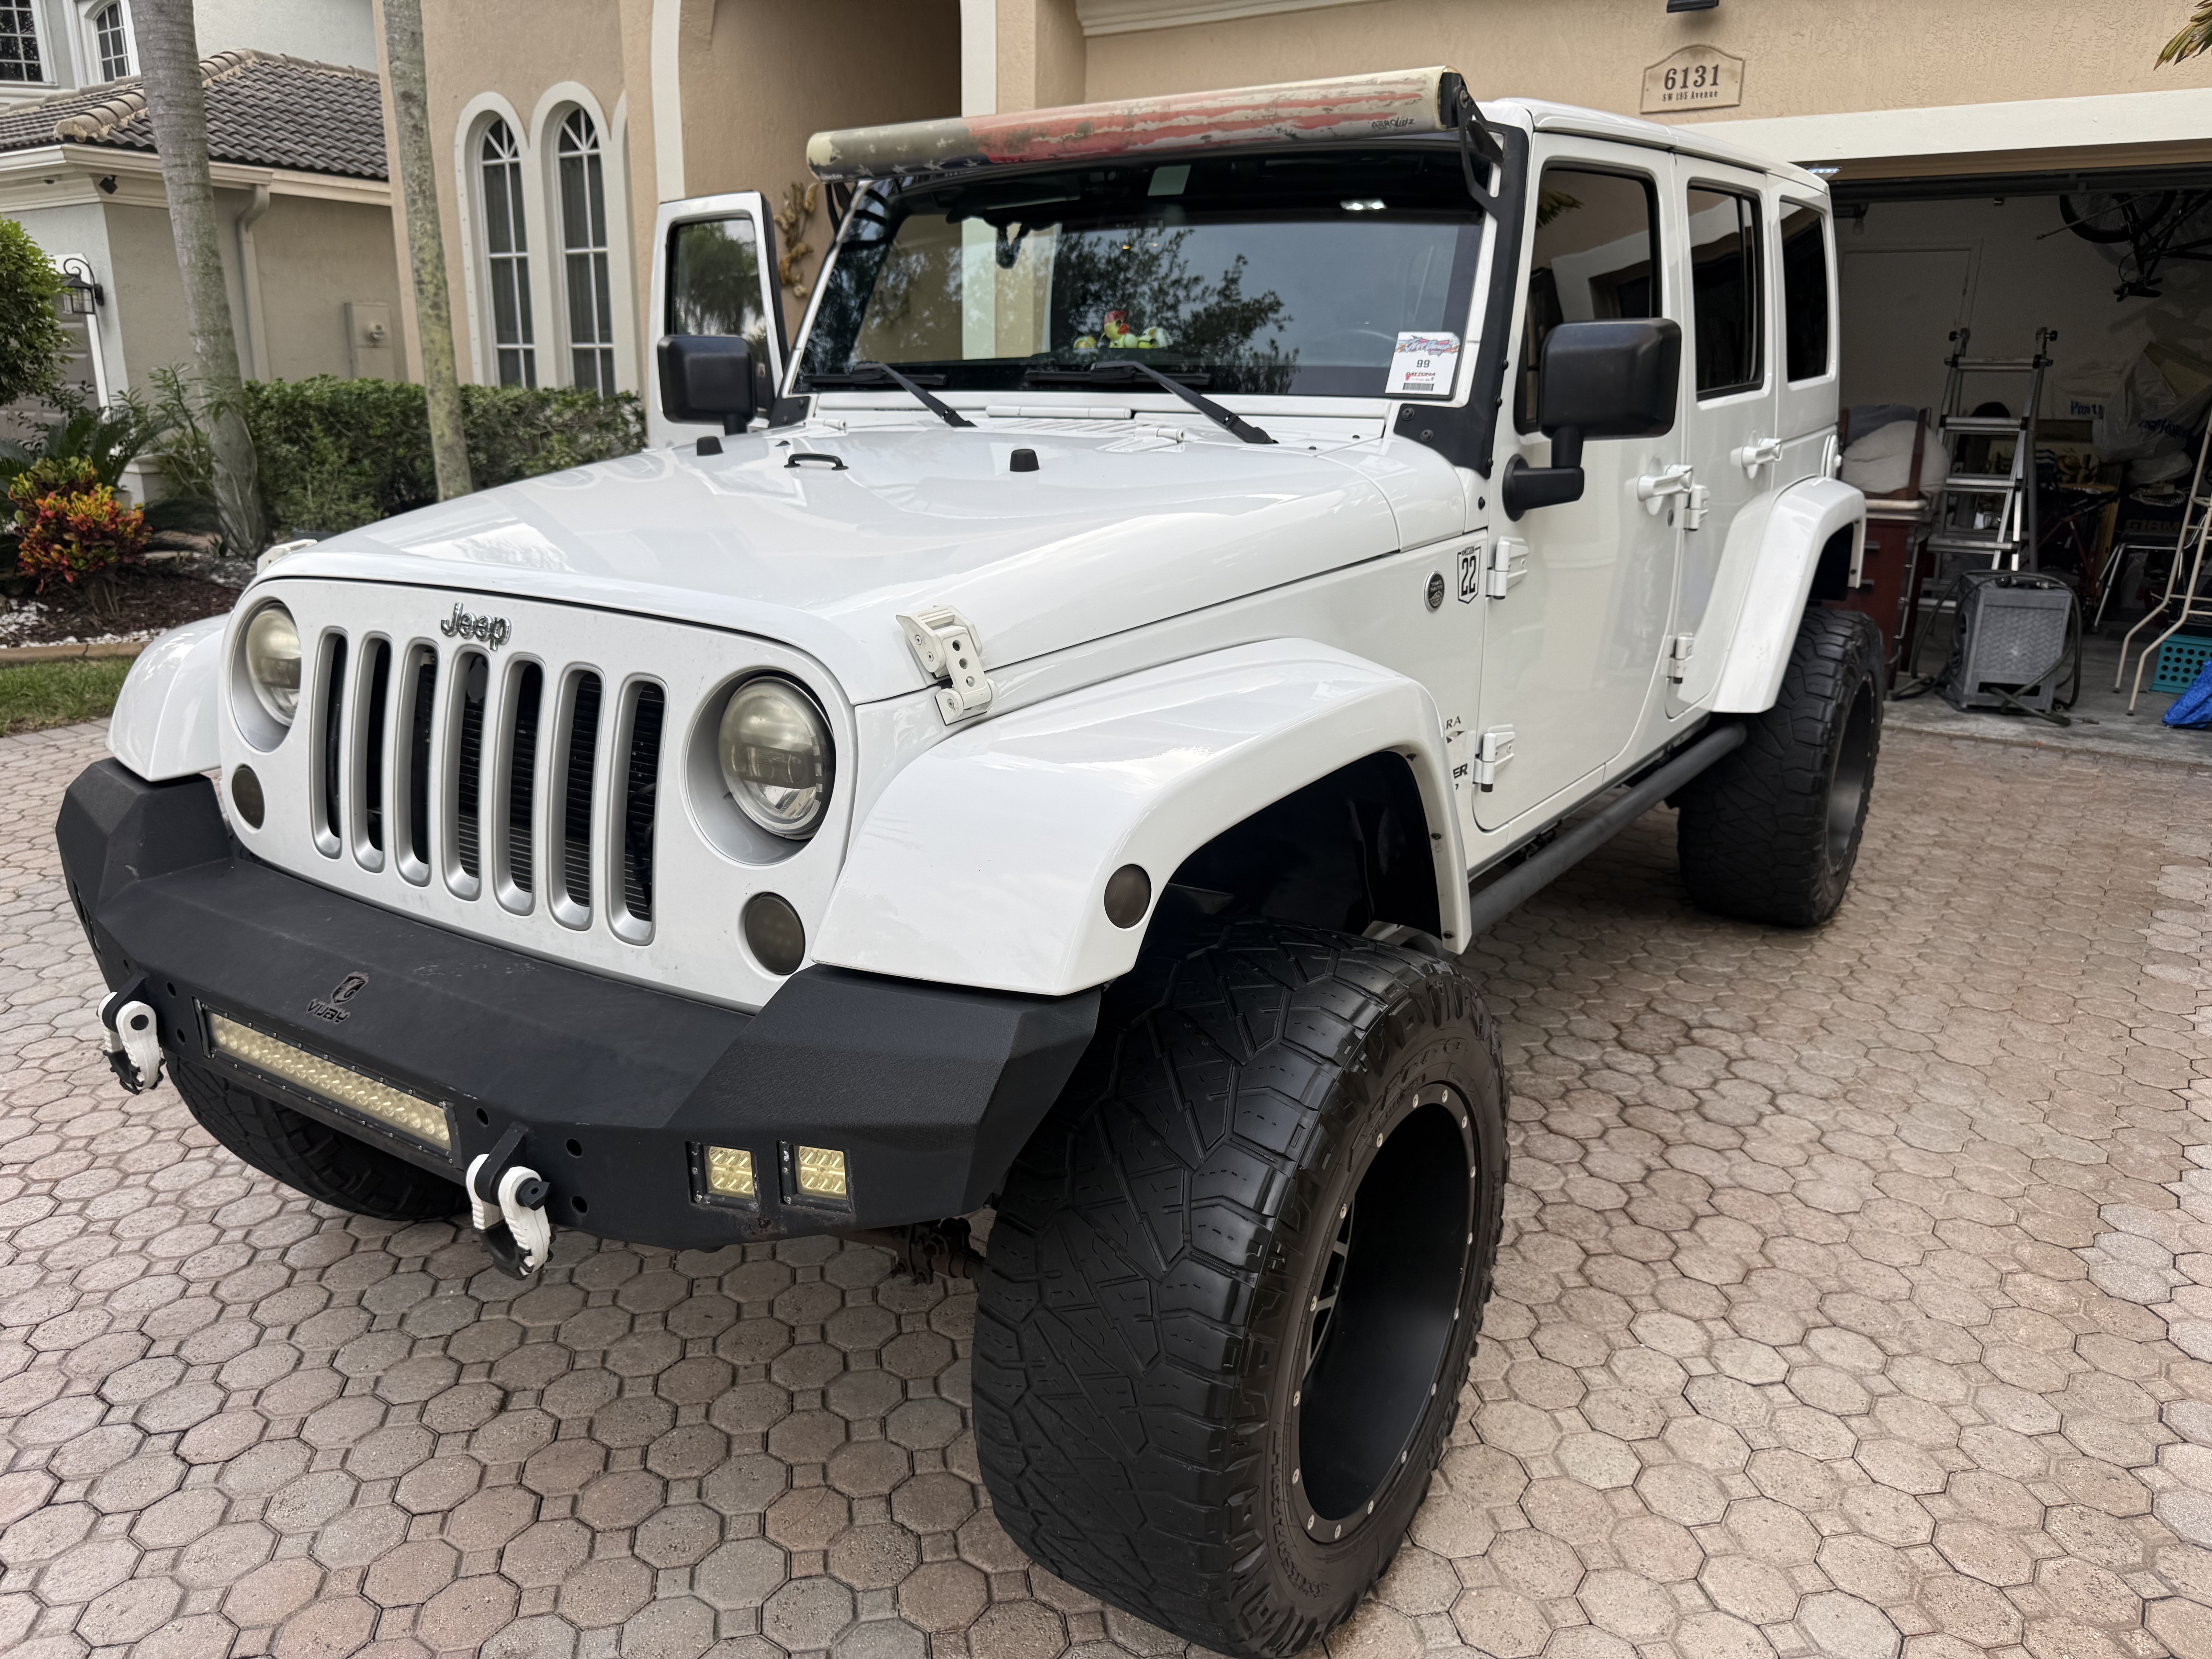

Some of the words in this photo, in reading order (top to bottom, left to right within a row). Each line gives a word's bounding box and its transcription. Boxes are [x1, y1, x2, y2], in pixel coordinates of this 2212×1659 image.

[1664, 64, 1719, 90] 6131
[1662, 93, 1673, 101] SW
[1691, 90, 1718, 100] Avenue
[1416, 359, 1430, 368] 99
[1461, 555, 1476, 596] 22
[441, 602, 512, 651] Jeep
